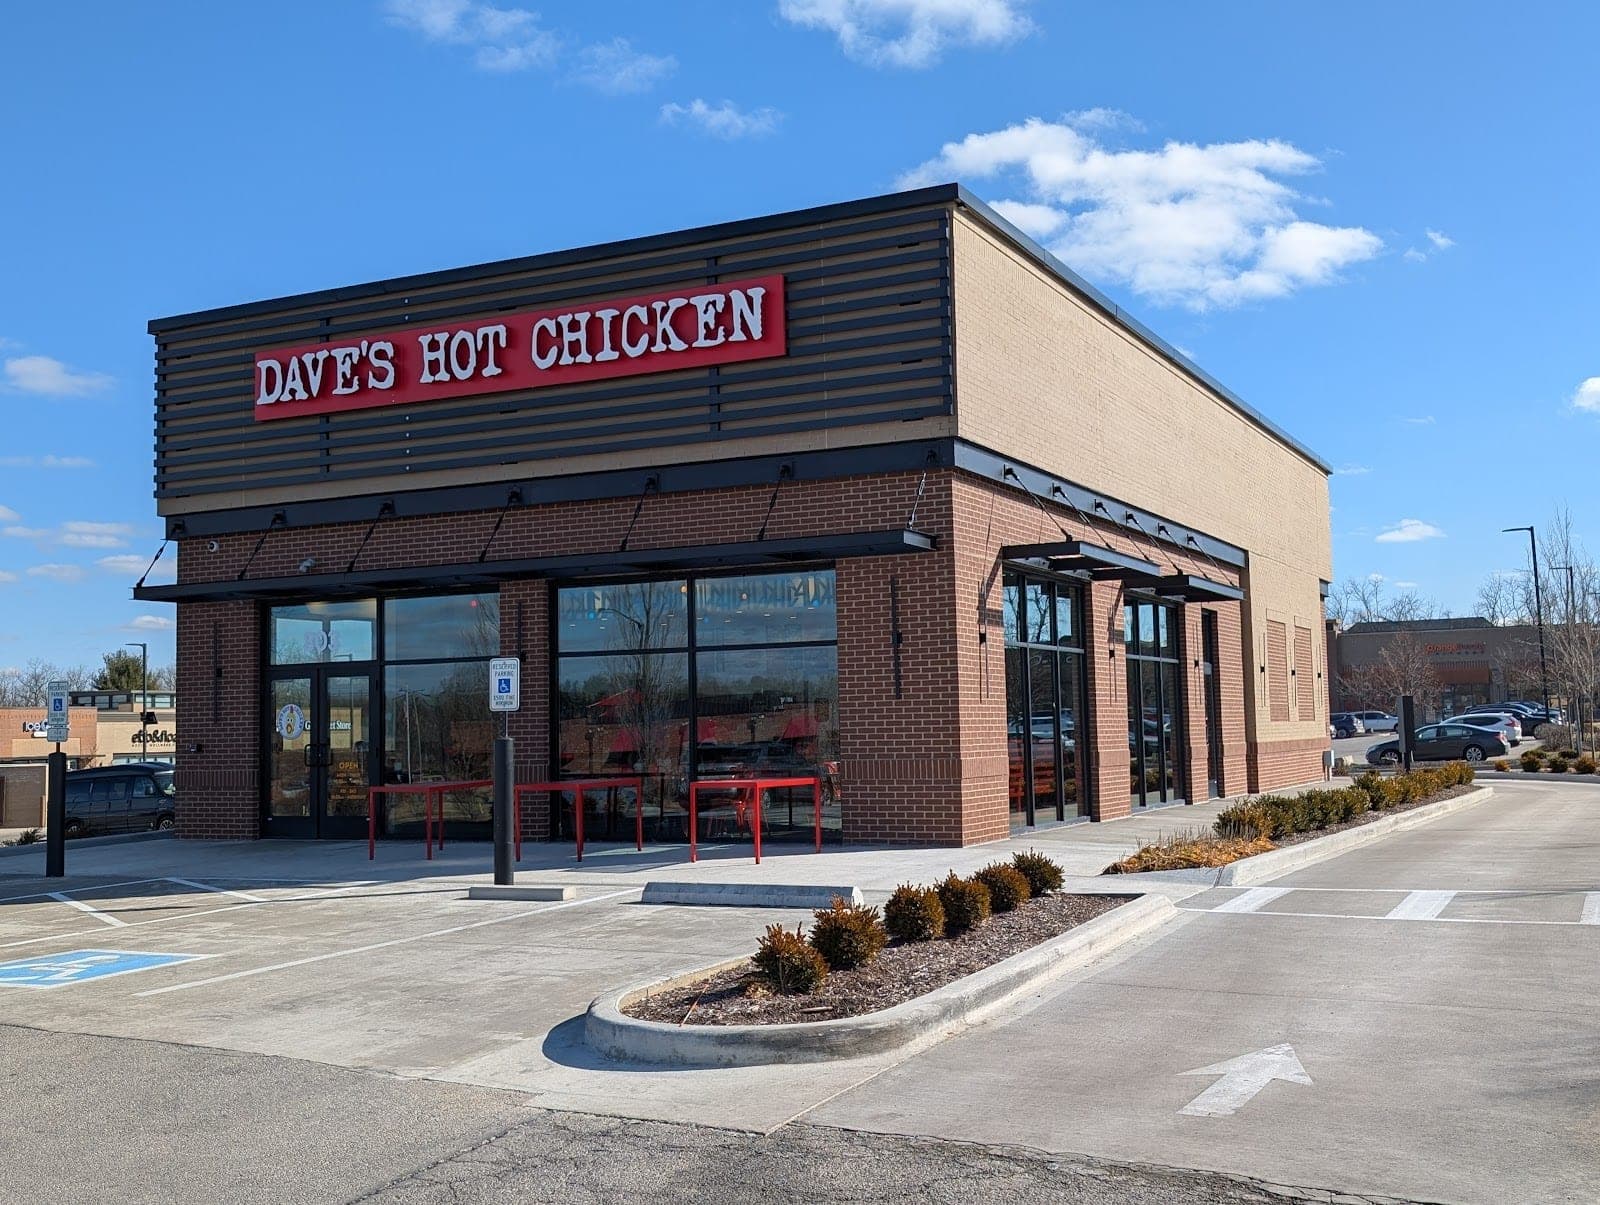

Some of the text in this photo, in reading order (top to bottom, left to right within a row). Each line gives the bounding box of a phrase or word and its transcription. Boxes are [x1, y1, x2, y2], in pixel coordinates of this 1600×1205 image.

[256, 286, 766, 405] DAVE'S HOT CHICKEN
[336, 720, 352, 730] Store
[338, 761, 359, 769] OPEN
